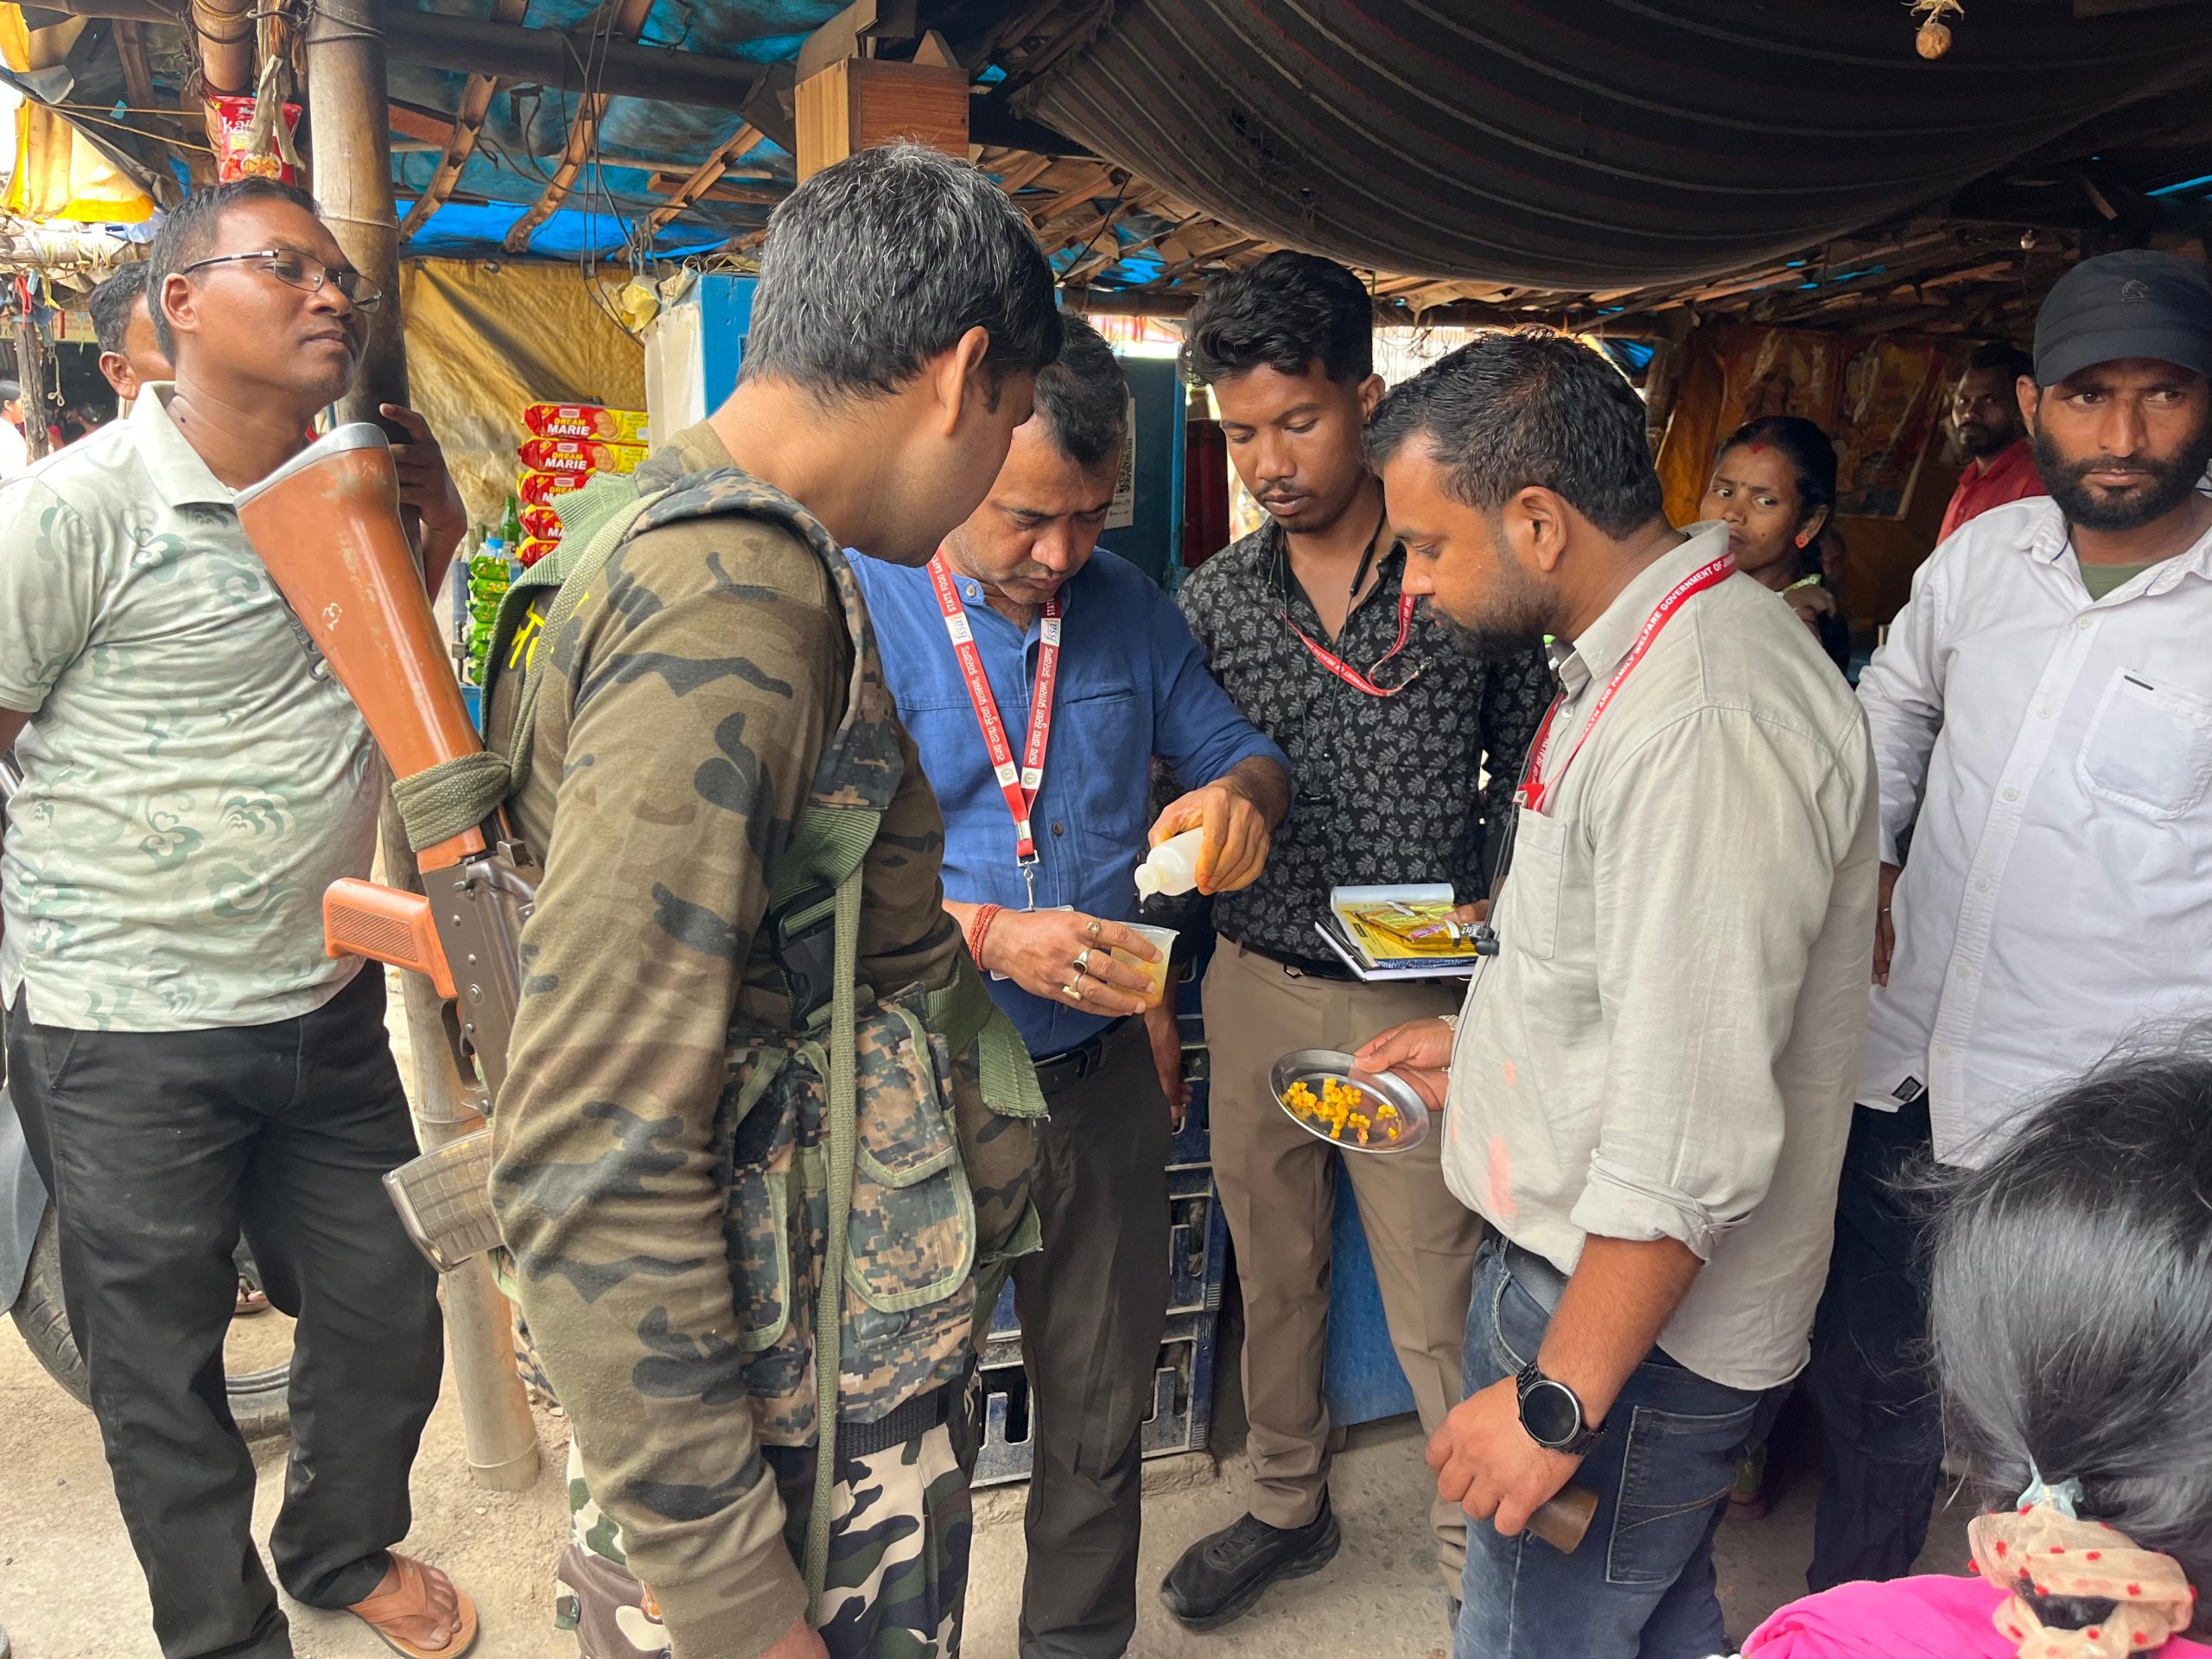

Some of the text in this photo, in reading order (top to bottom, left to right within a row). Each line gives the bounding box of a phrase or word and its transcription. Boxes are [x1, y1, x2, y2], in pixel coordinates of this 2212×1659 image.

[547, 423, 590, 435] MARIE
[554, 417, 586, 426] DREAM
[544, 458, 588, 470] MARIE
[552, 452, 583, 461] DREAM
[937, 574, 949, 592] FOOD
[943, 592, 957, 613] STATE
[1599, 688, 1612, 709] AND
[1611, 655, 1635, 687] FAMILY
[1634, 610, 1662, 654] WELFARE
[1660, 567, 1713, 611] GOVERNMENT
[1713, 561, 1722, 571] OF
[960, 645, 978, 676] झारखण्ड
[1041, 646, 1053, 677] झारखण्ड
[981, 705, 997, 726] सुरक्षा
[1034, 709, 1048, 729] सुरक्षा
[987, 726, 1000, 744] खाद्य
[1031, 729, 1041, 747] खाद्य
[994, 744, 1005, 762] राज्य
[1028, 747, 1039, 765] राज्य
